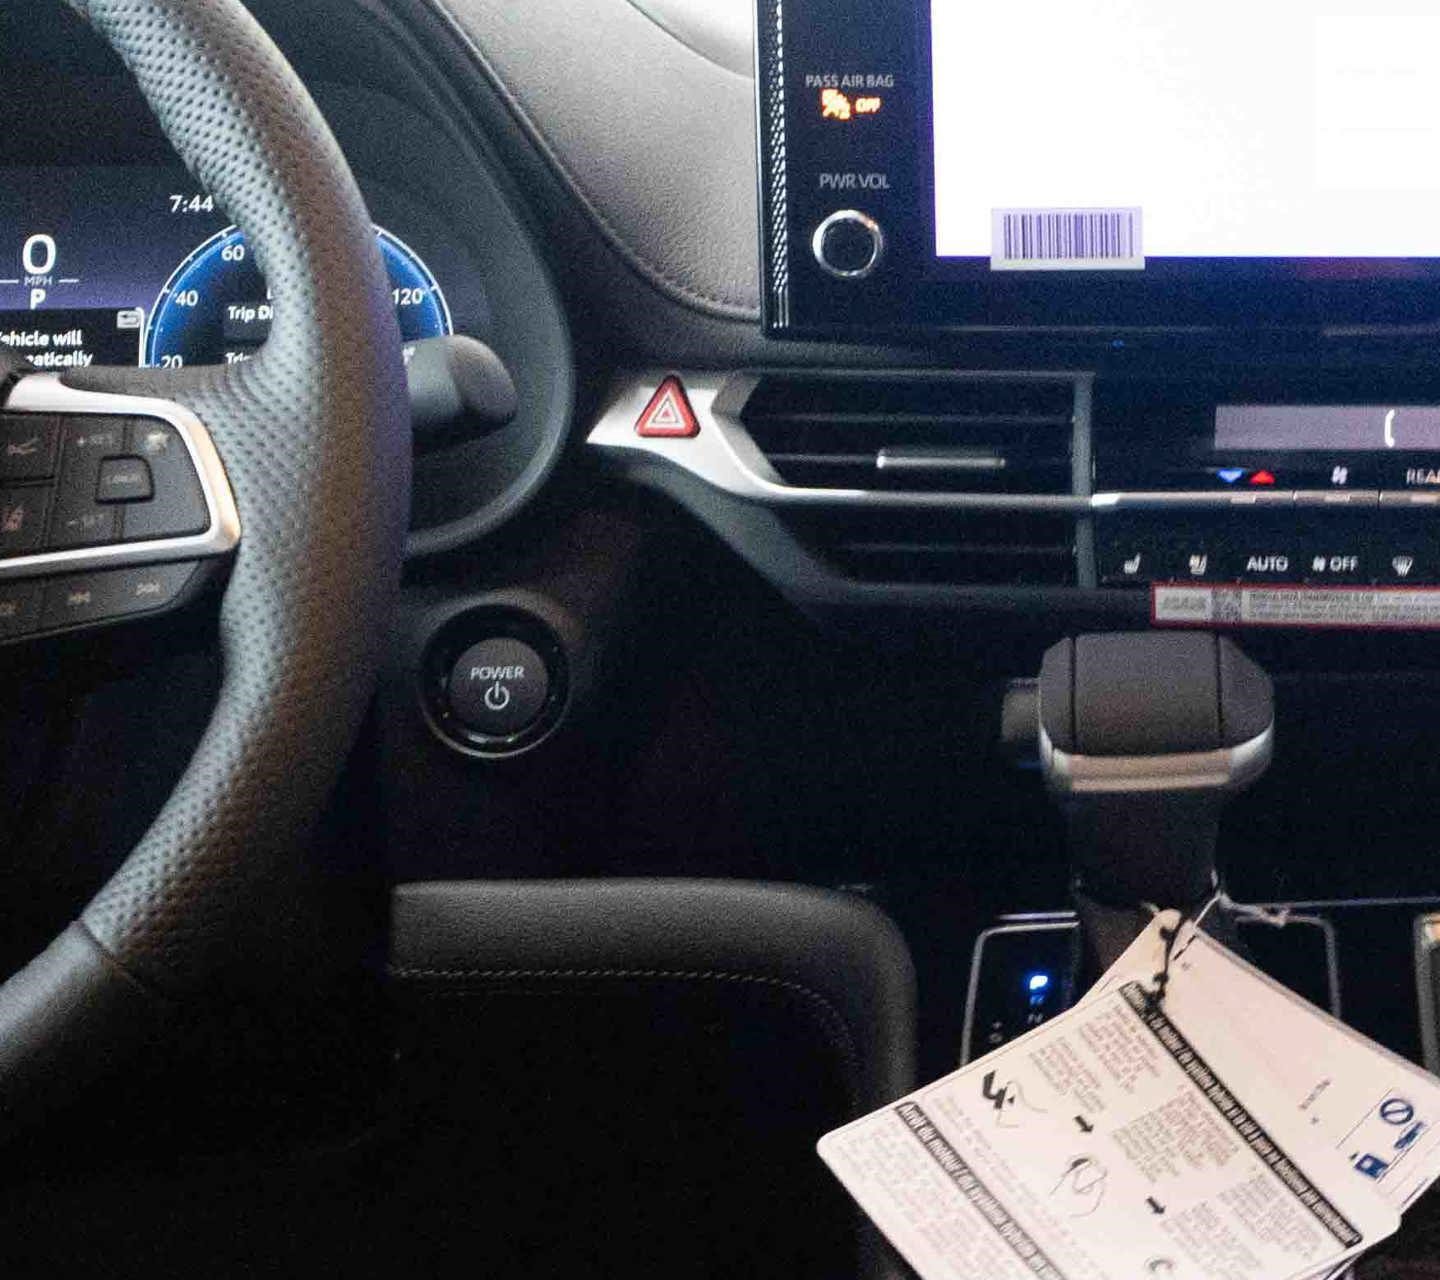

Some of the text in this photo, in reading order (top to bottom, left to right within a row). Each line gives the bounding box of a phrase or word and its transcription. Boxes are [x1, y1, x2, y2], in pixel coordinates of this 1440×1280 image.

[805, 74, 895, 88] PASS AIR BAG
[819, 173, 890, 189] PWR VOL
[169, 195, 214, 214] 7:44
[21, 233, 57, 276] 0
[221, 245, 245, 262] 60
[30, 288, 47, 310] P
[175, 289, 199, 307] 40
[392, 287, 423, 306] 120
[227, 305, 256, 323] Trip
[52, 328, 83, 346] will
[25, 349, 94, 368] atically
[1246, 555, 1289, 572] AUTO
[1329, 555, 1359, 572] OFF
[470, 665, 526, 681] POWER
